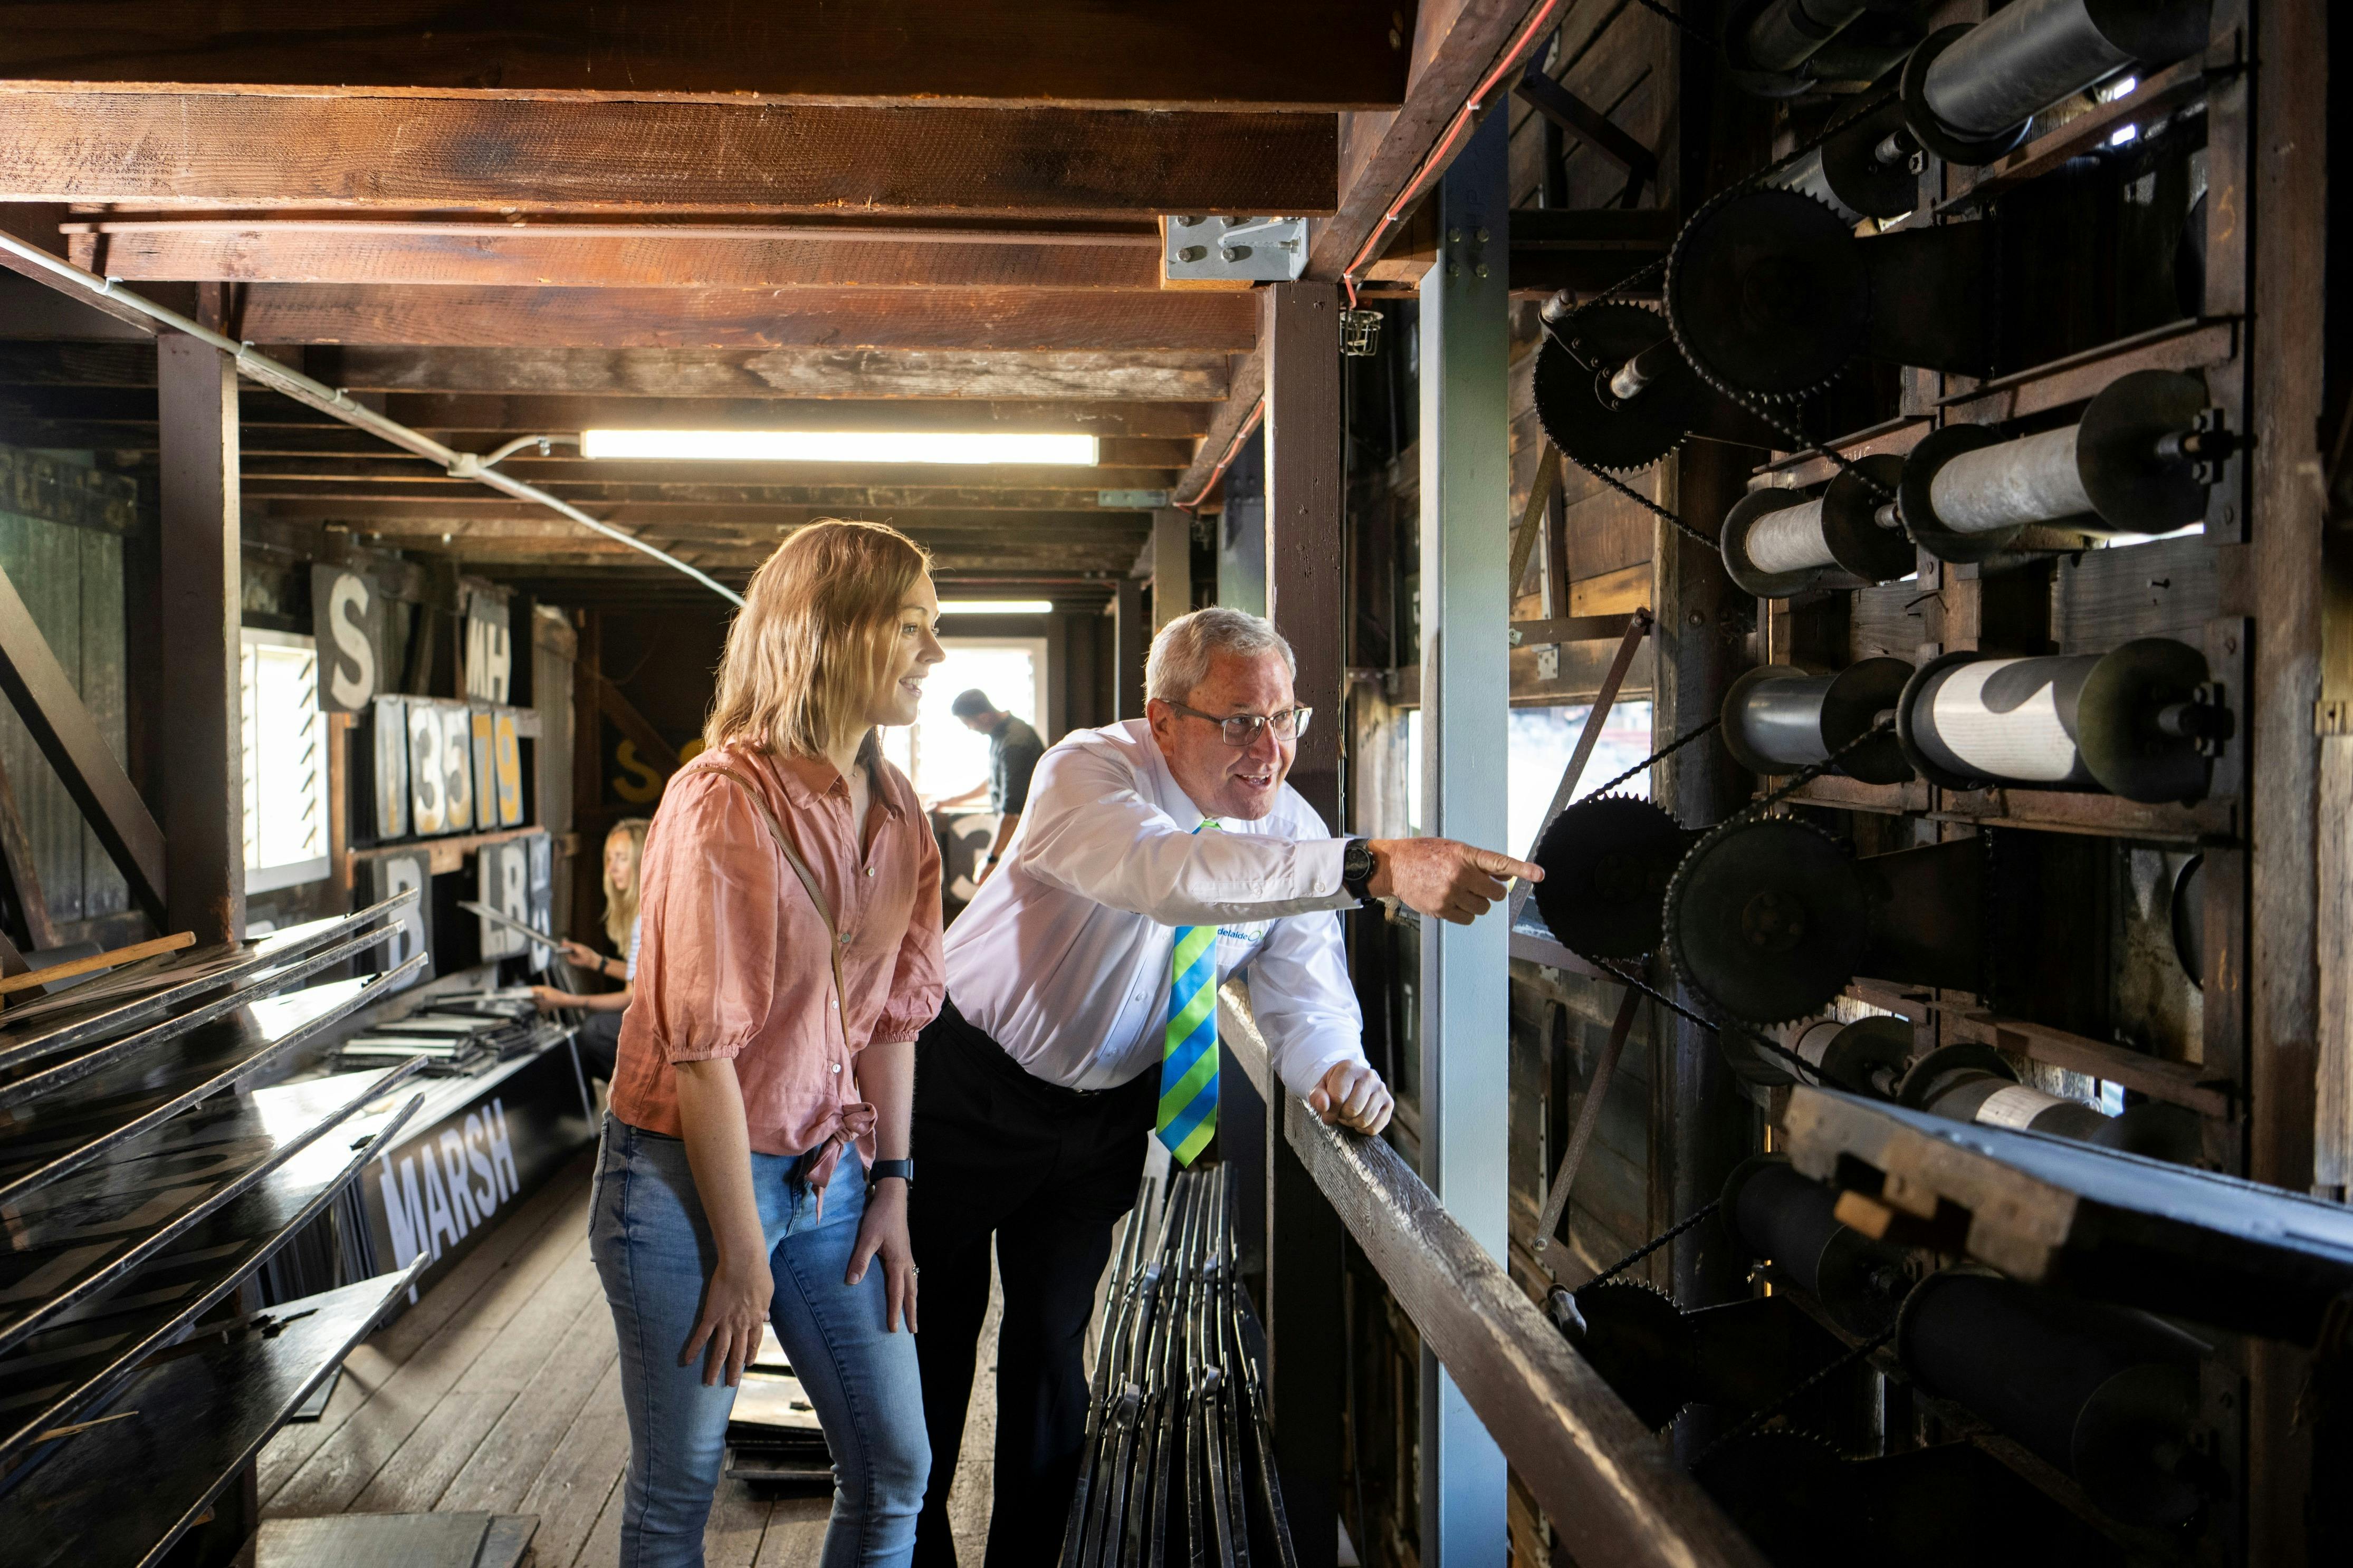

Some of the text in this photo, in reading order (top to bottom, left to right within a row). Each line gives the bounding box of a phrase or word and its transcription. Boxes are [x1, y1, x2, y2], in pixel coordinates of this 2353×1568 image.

[329, 573, 375, 709] S
[387, 857, 424, 993] B
[1217, 927, 1247, 940] delaide
[379, 1097, 519, 1306] MARSH
